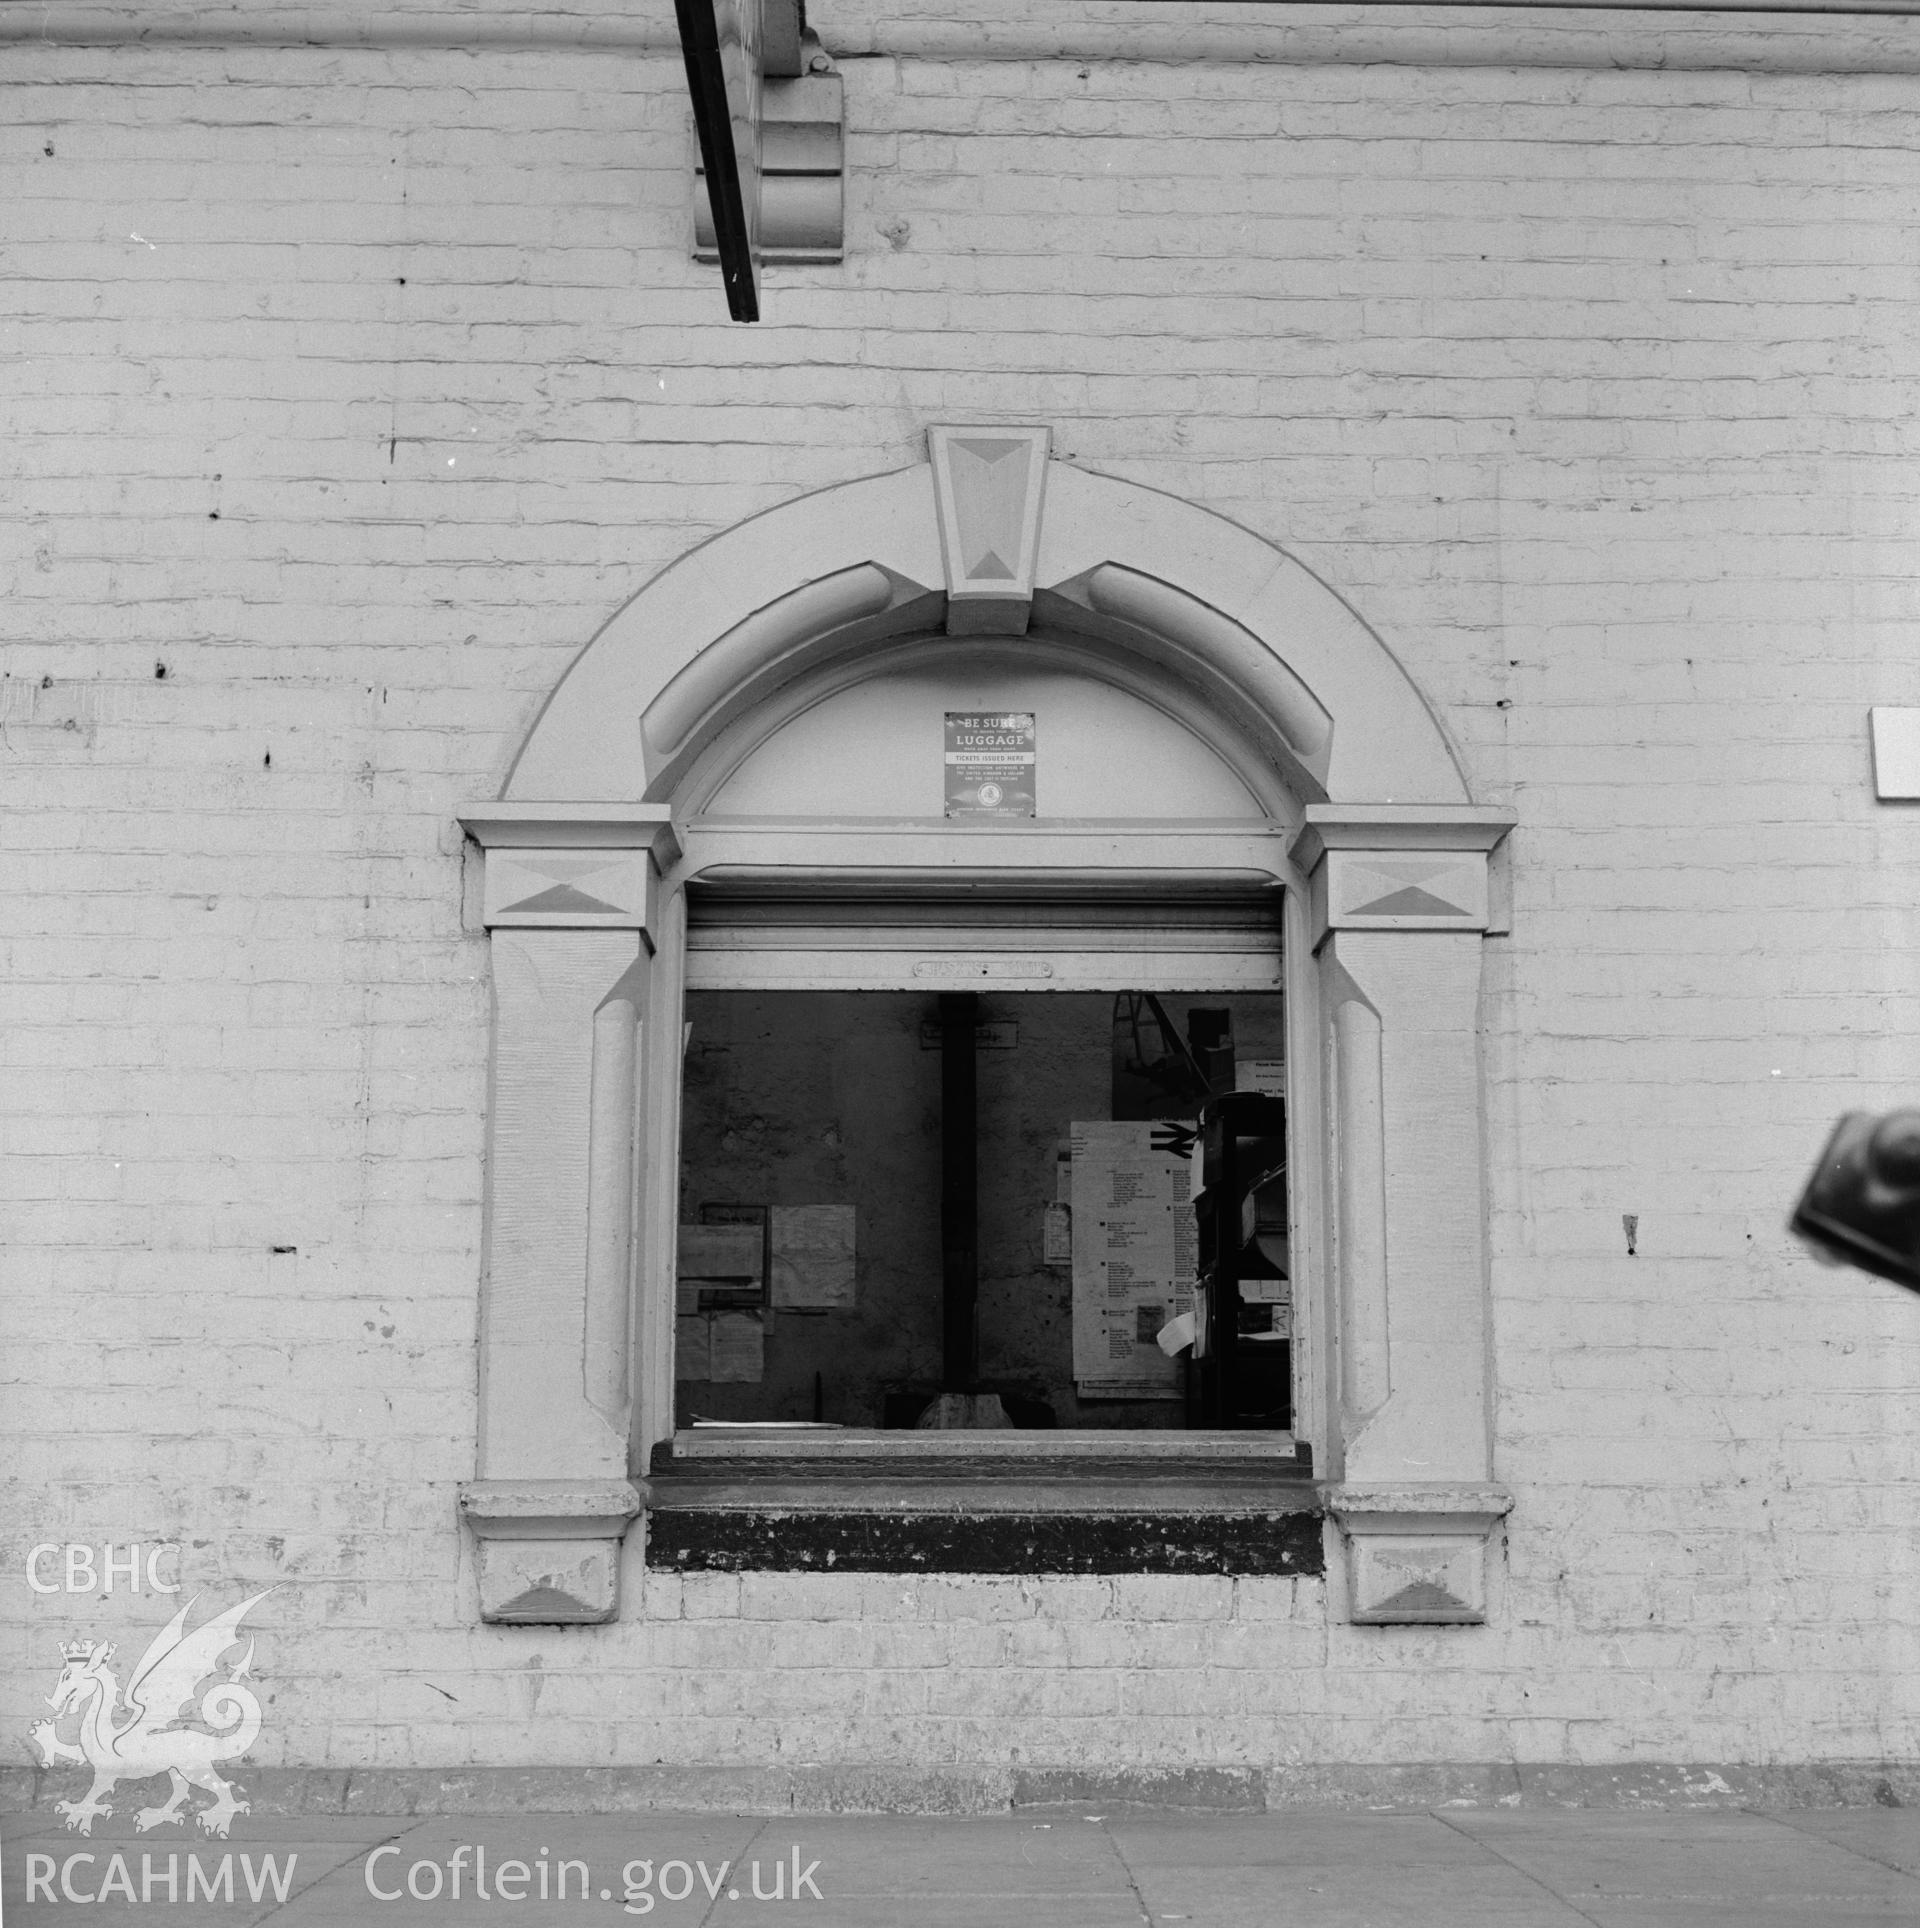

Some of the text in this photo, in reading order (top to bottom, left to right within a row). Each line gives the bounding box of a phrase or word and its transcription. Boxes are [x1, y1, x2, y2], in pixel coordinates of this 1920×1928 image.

[964, 718, 1016, 728] BE SURE
[956, 735, 1024, 745] LUGGAGE
